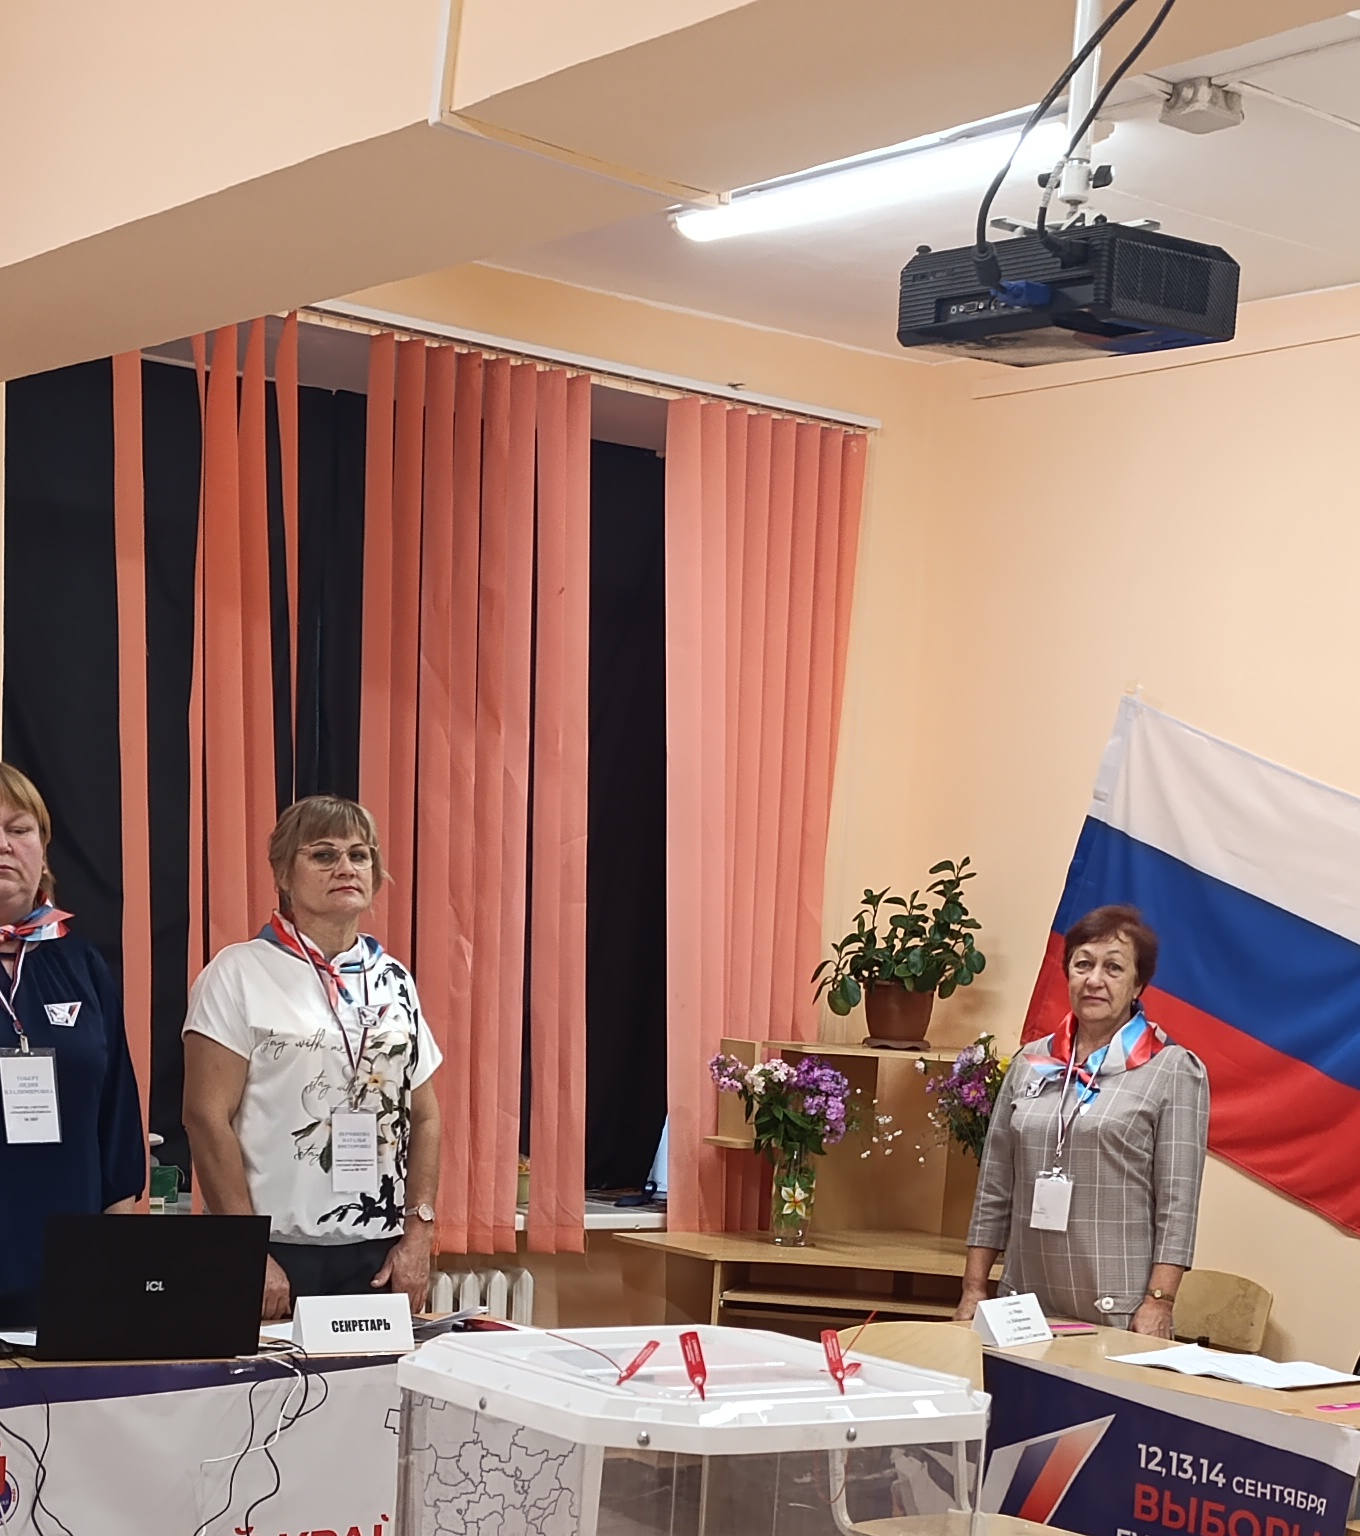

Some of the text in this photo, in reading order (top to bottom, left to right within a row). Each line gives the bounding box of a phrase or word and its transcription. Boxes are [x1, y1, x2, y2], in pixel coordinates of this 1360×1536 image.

[331, 1318, 391, 1334] СЕКРЕТАРЬ
[1137, 1443, 1327, 1516] 12,13,14 СЕНТЯБРЯ
